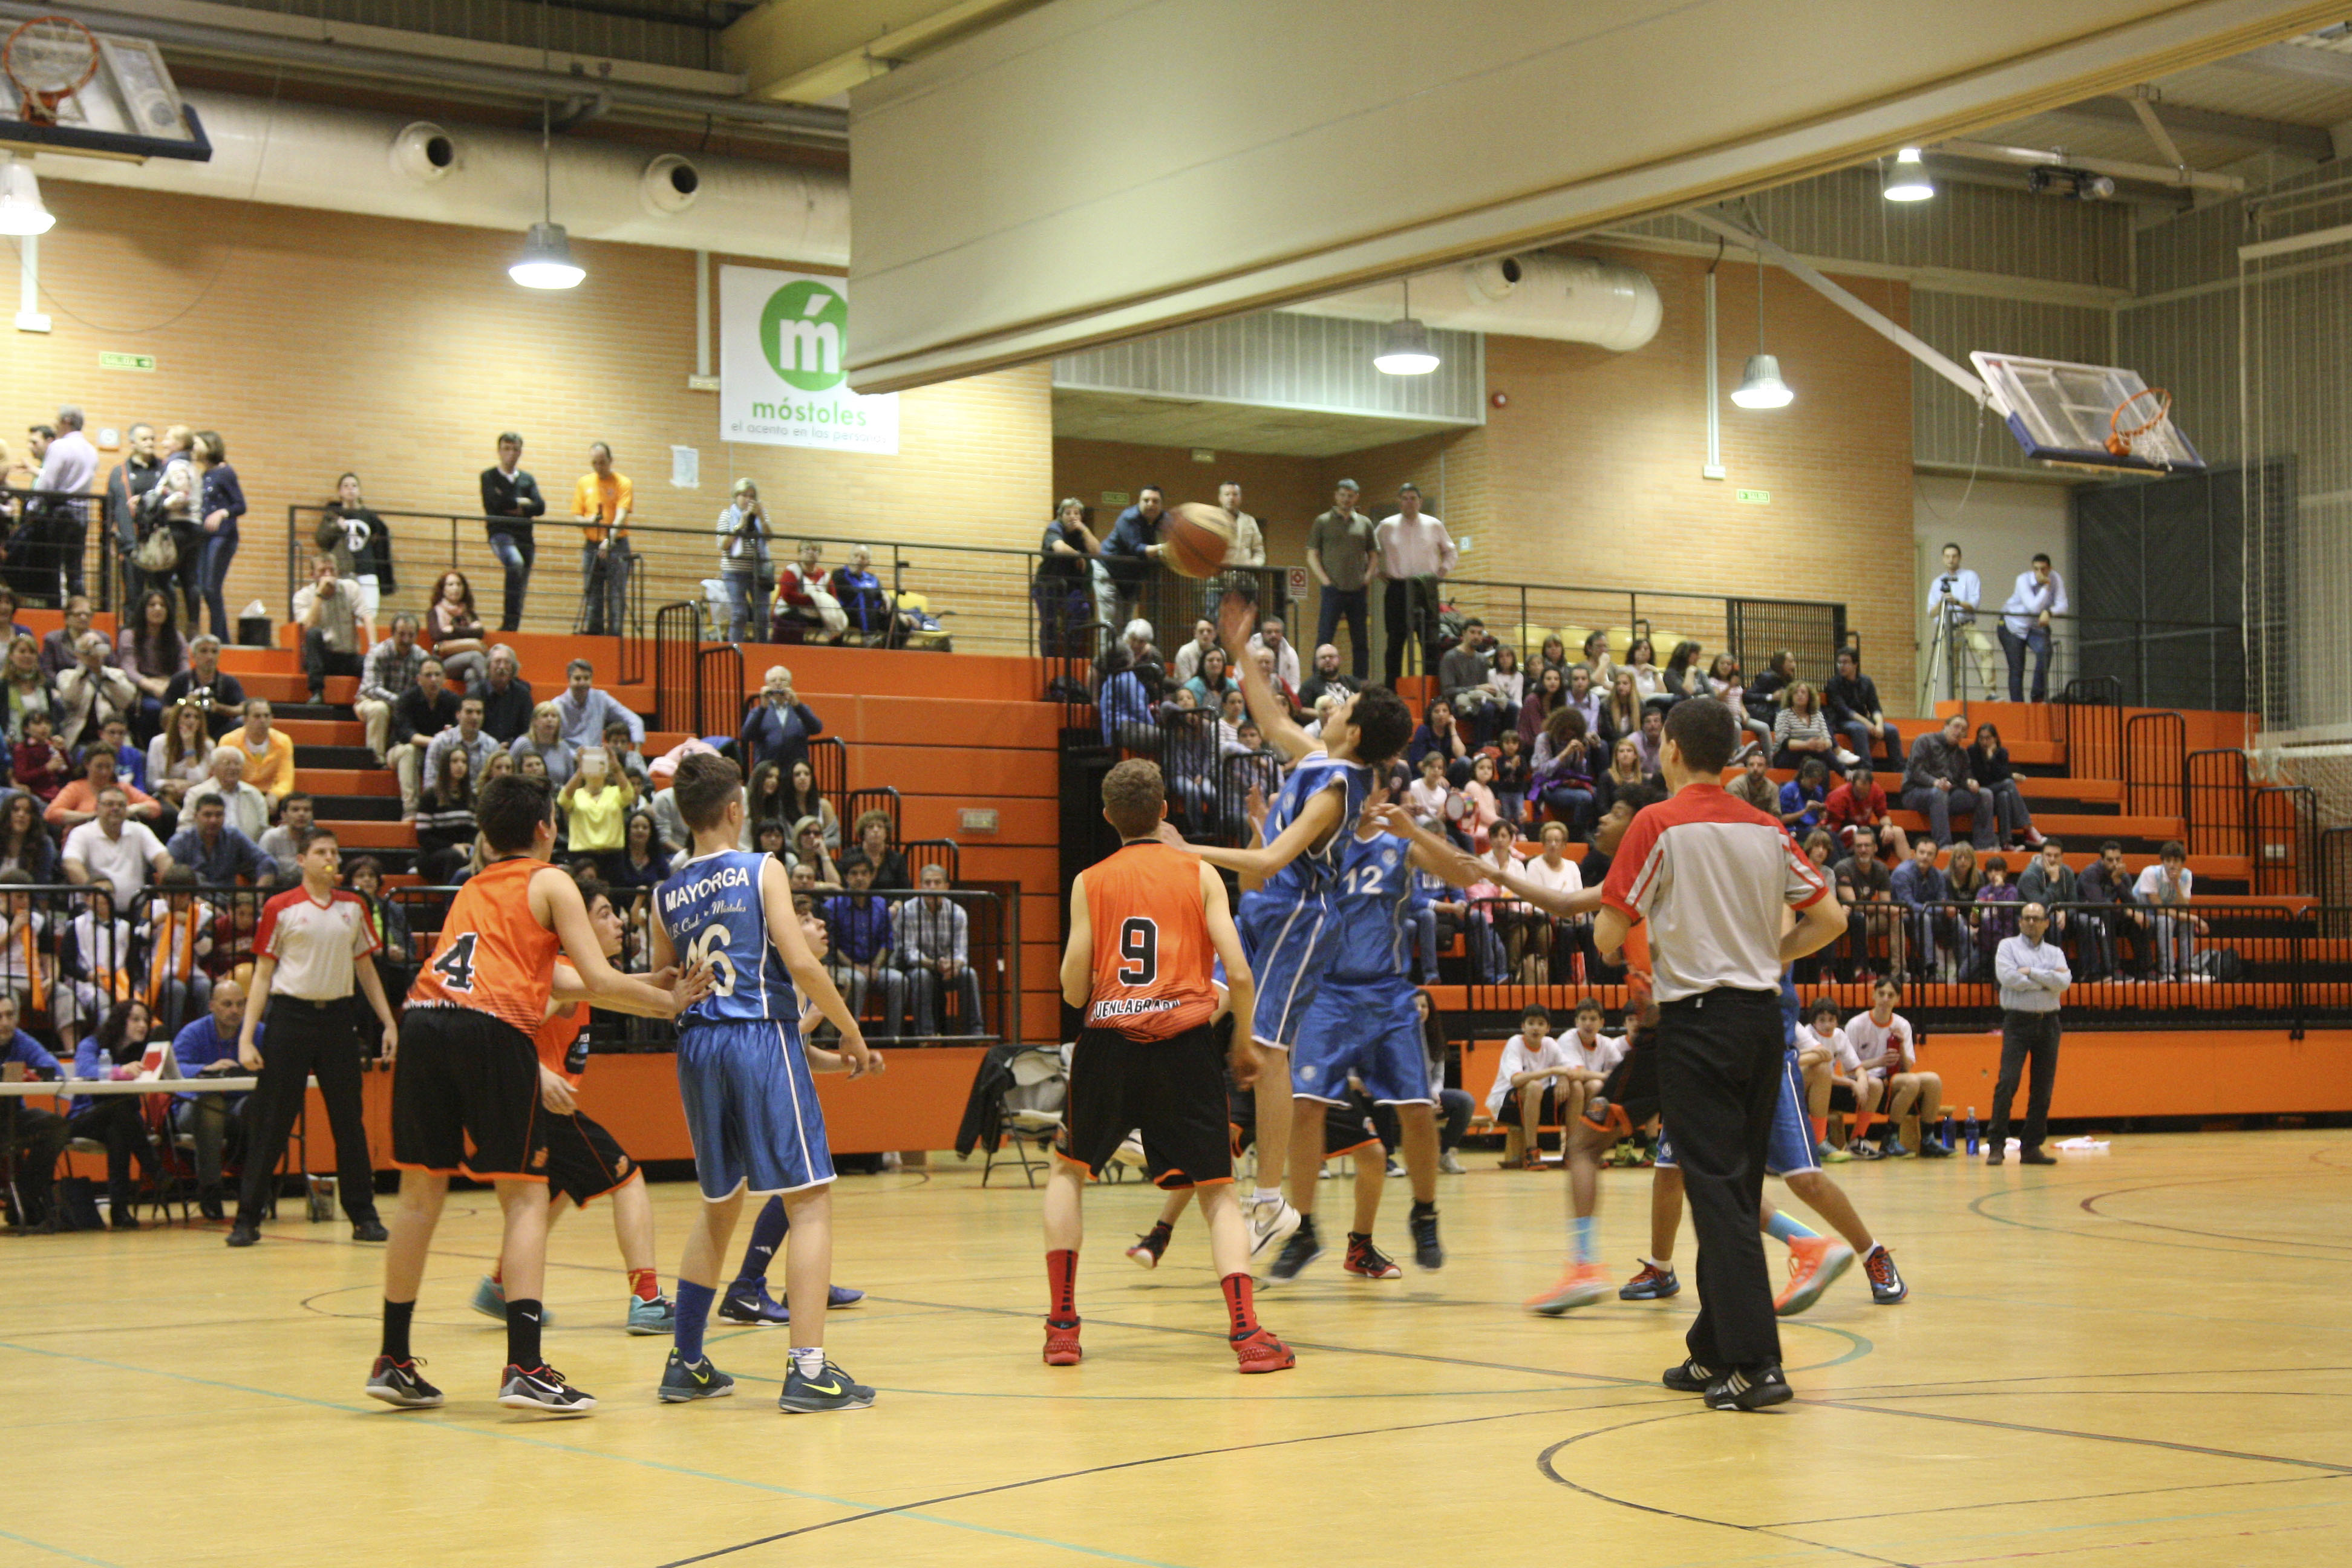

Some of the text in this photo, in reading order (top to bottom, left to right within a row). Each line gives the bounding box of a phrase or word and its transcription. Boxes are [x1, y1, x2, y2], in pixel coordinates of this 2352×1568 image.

[731, 421, 742, 432] el
[746, 423, 788, 436] acento
[792, 427, 807, 437] en
[811, 426, 829, 439] las
[752, 397, 867, 426] móstoles
[665, 866, 750, 913] MAYORGA
[1342, 865, 1383, 894] 12
[432, 932, 479, 994] 4
[1118, 916, 1158, 987] 9
